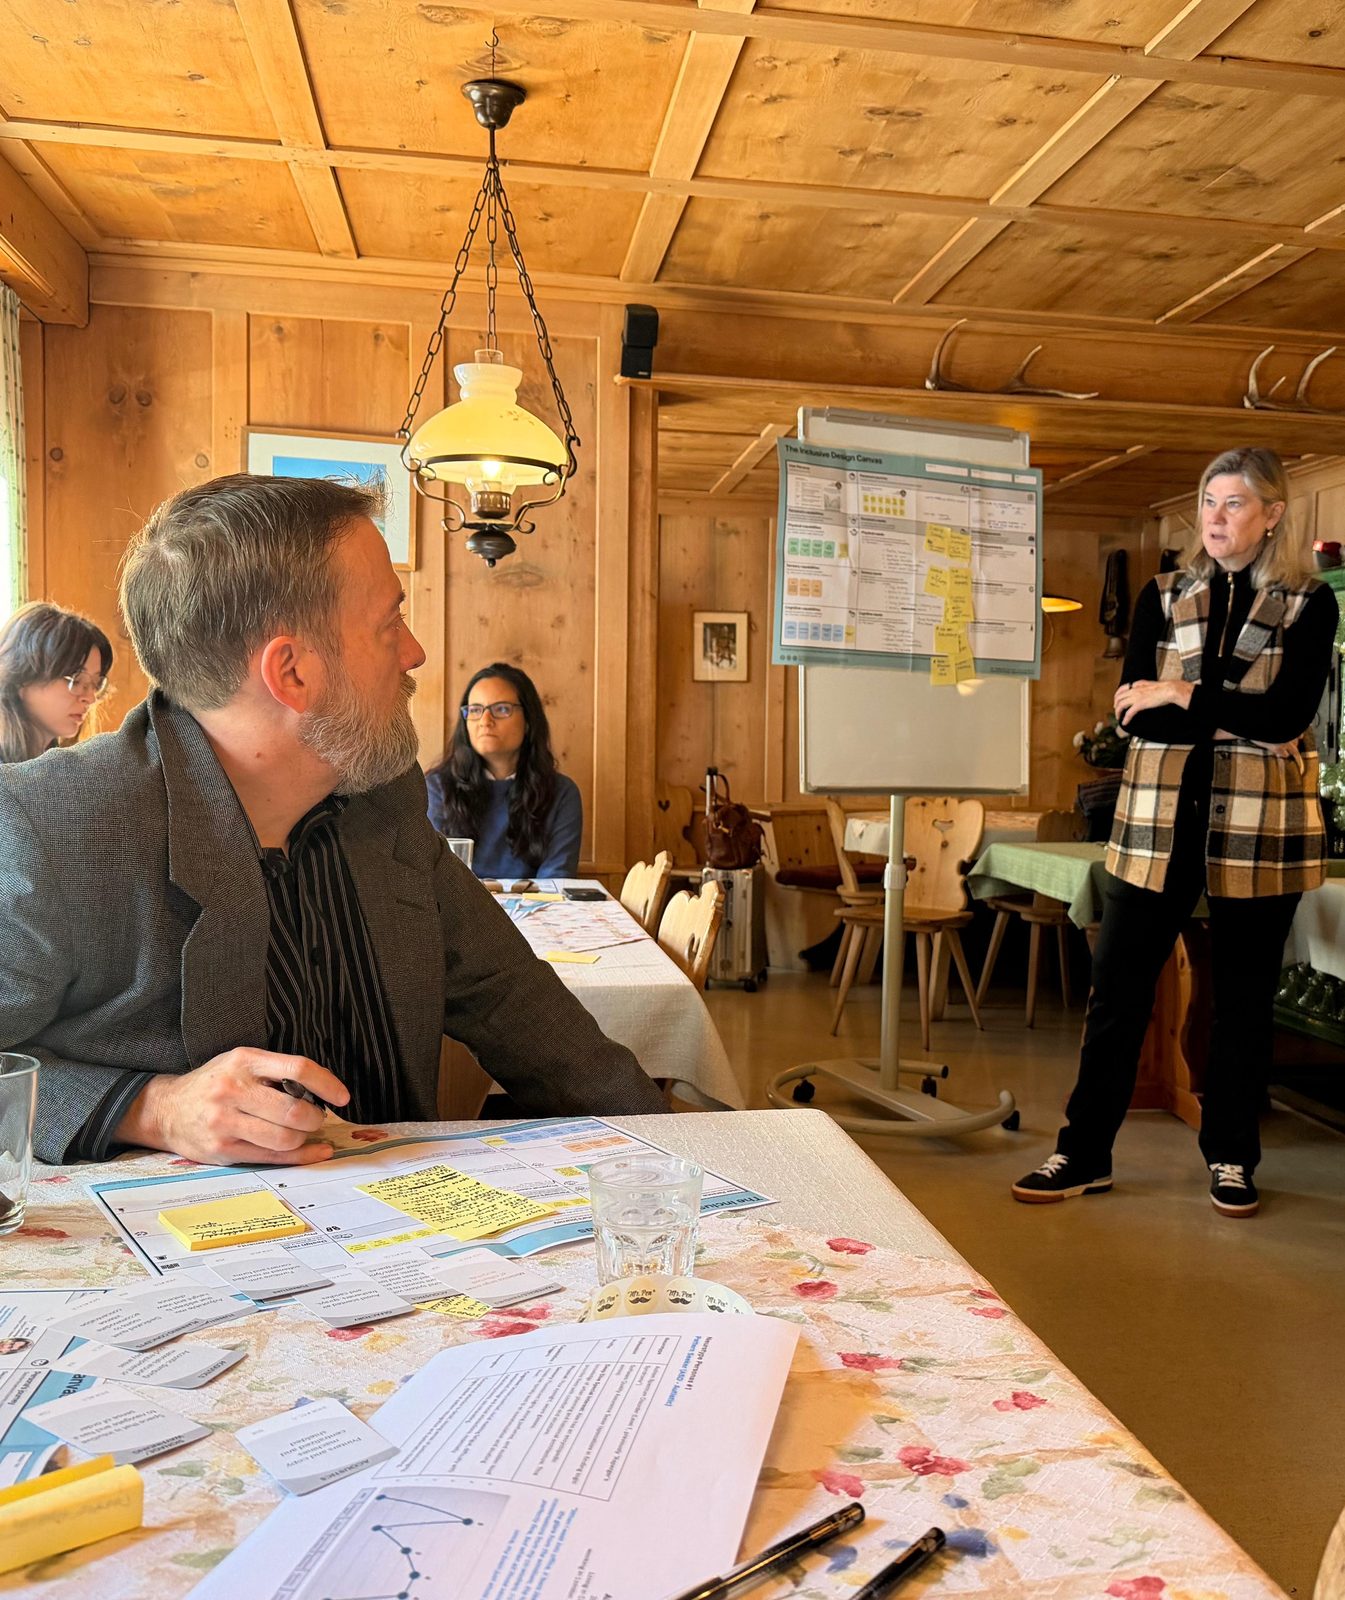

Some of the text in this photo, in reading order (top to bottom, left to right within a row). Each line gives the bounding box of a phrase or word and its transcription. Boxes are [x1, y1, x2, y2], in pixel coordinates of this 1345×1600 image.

[785, 445, 883, 464] The Inclusive Design Canvas
[736, 1195, 762, 1205] The
[229, 1273, 263, 1281] rounded
[695, 1336, 712, 1360] Neurotype
[663, 1335, 701, 1406] Pattern Seeker (ASD Autistic)
[686, 1360, 702, 1383] Personas
[110, 1410, 136, 1419] sense
[136, 1413, 166, 1424] Space
[77, 1421, 104, 1431] order
[93, 1424, 113, 1432] and
[78, 1431, 115, 1443] intuitive
[279, 1429, 346, 1456] centralized and
[289, 1430, 327, 1446] shielded
[285, 1436, 361, 1467] Printers and copy
[297, 1438, 340, 1456] machines
[318, 1459, 370, 1481] ACOUSTICS
